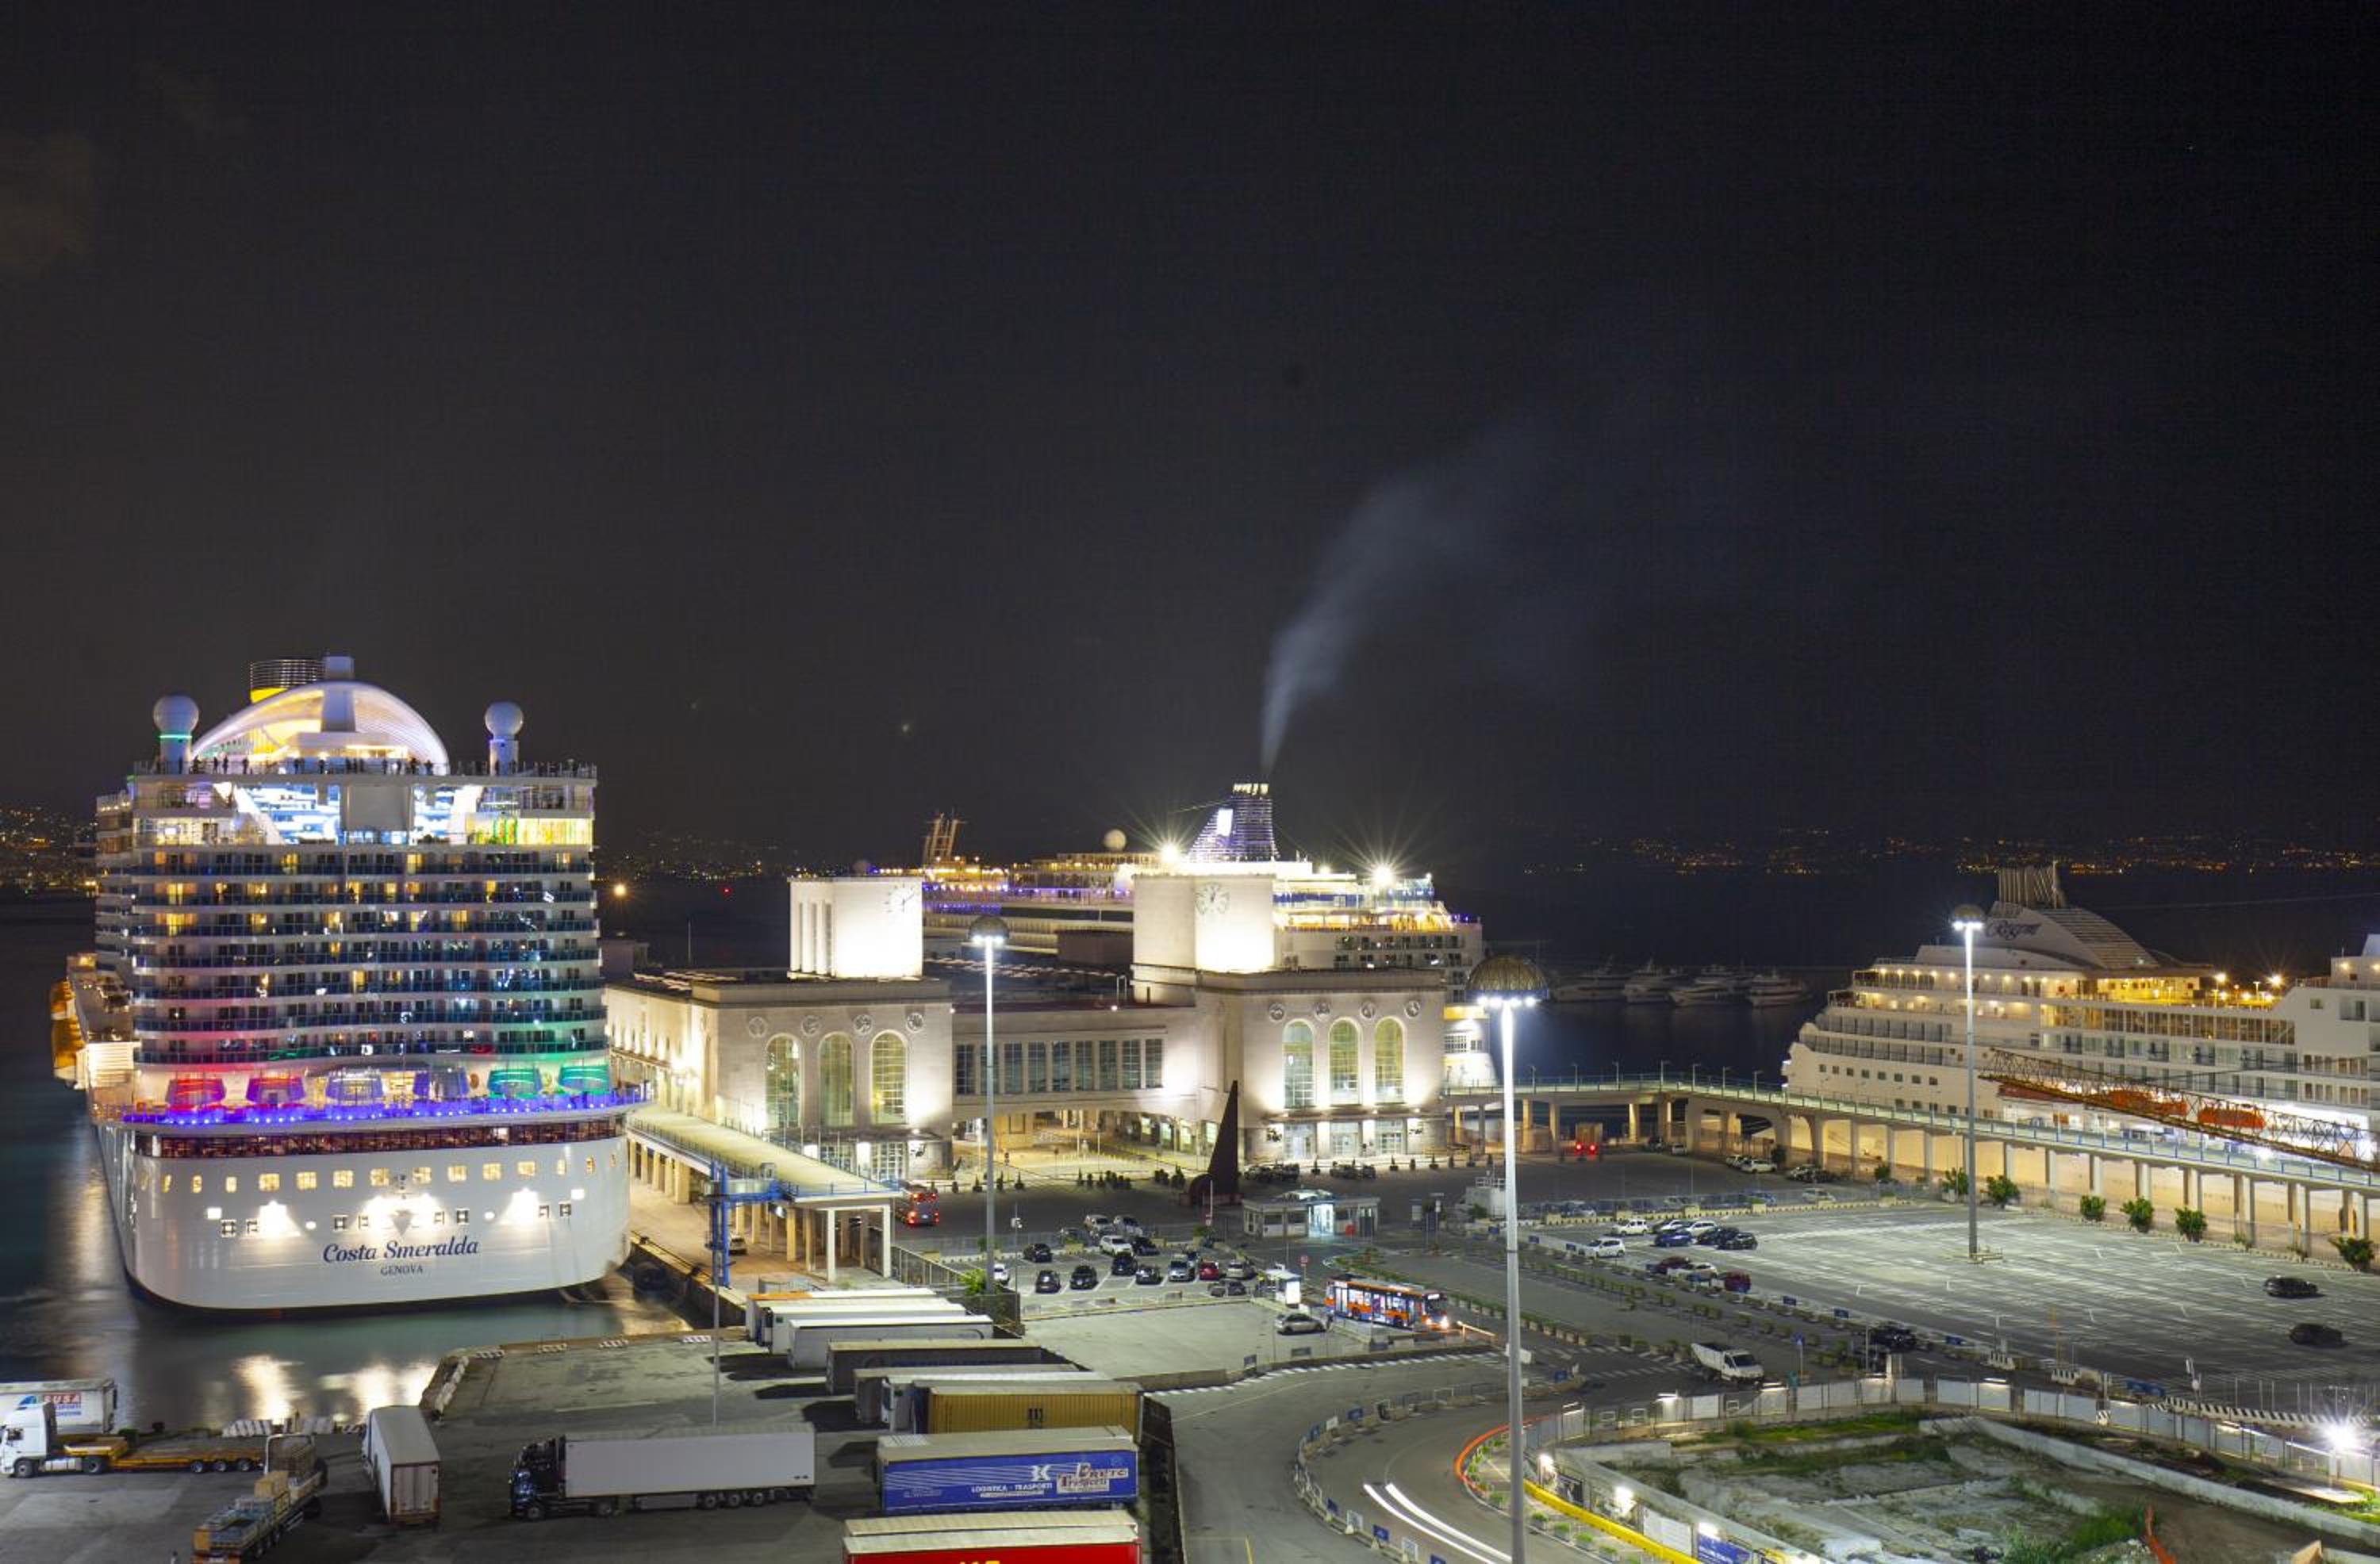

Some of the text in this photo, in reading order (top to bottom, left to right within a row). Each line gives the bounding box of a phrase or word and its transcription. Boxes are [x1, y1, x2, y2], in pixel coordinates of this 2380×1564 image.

[323, 1236, 479, 1263] Costa Smeralda
[380, 1264, 424, 1275] GENOVA
[970, 1485, 1008, 1493] LOGISTICA
